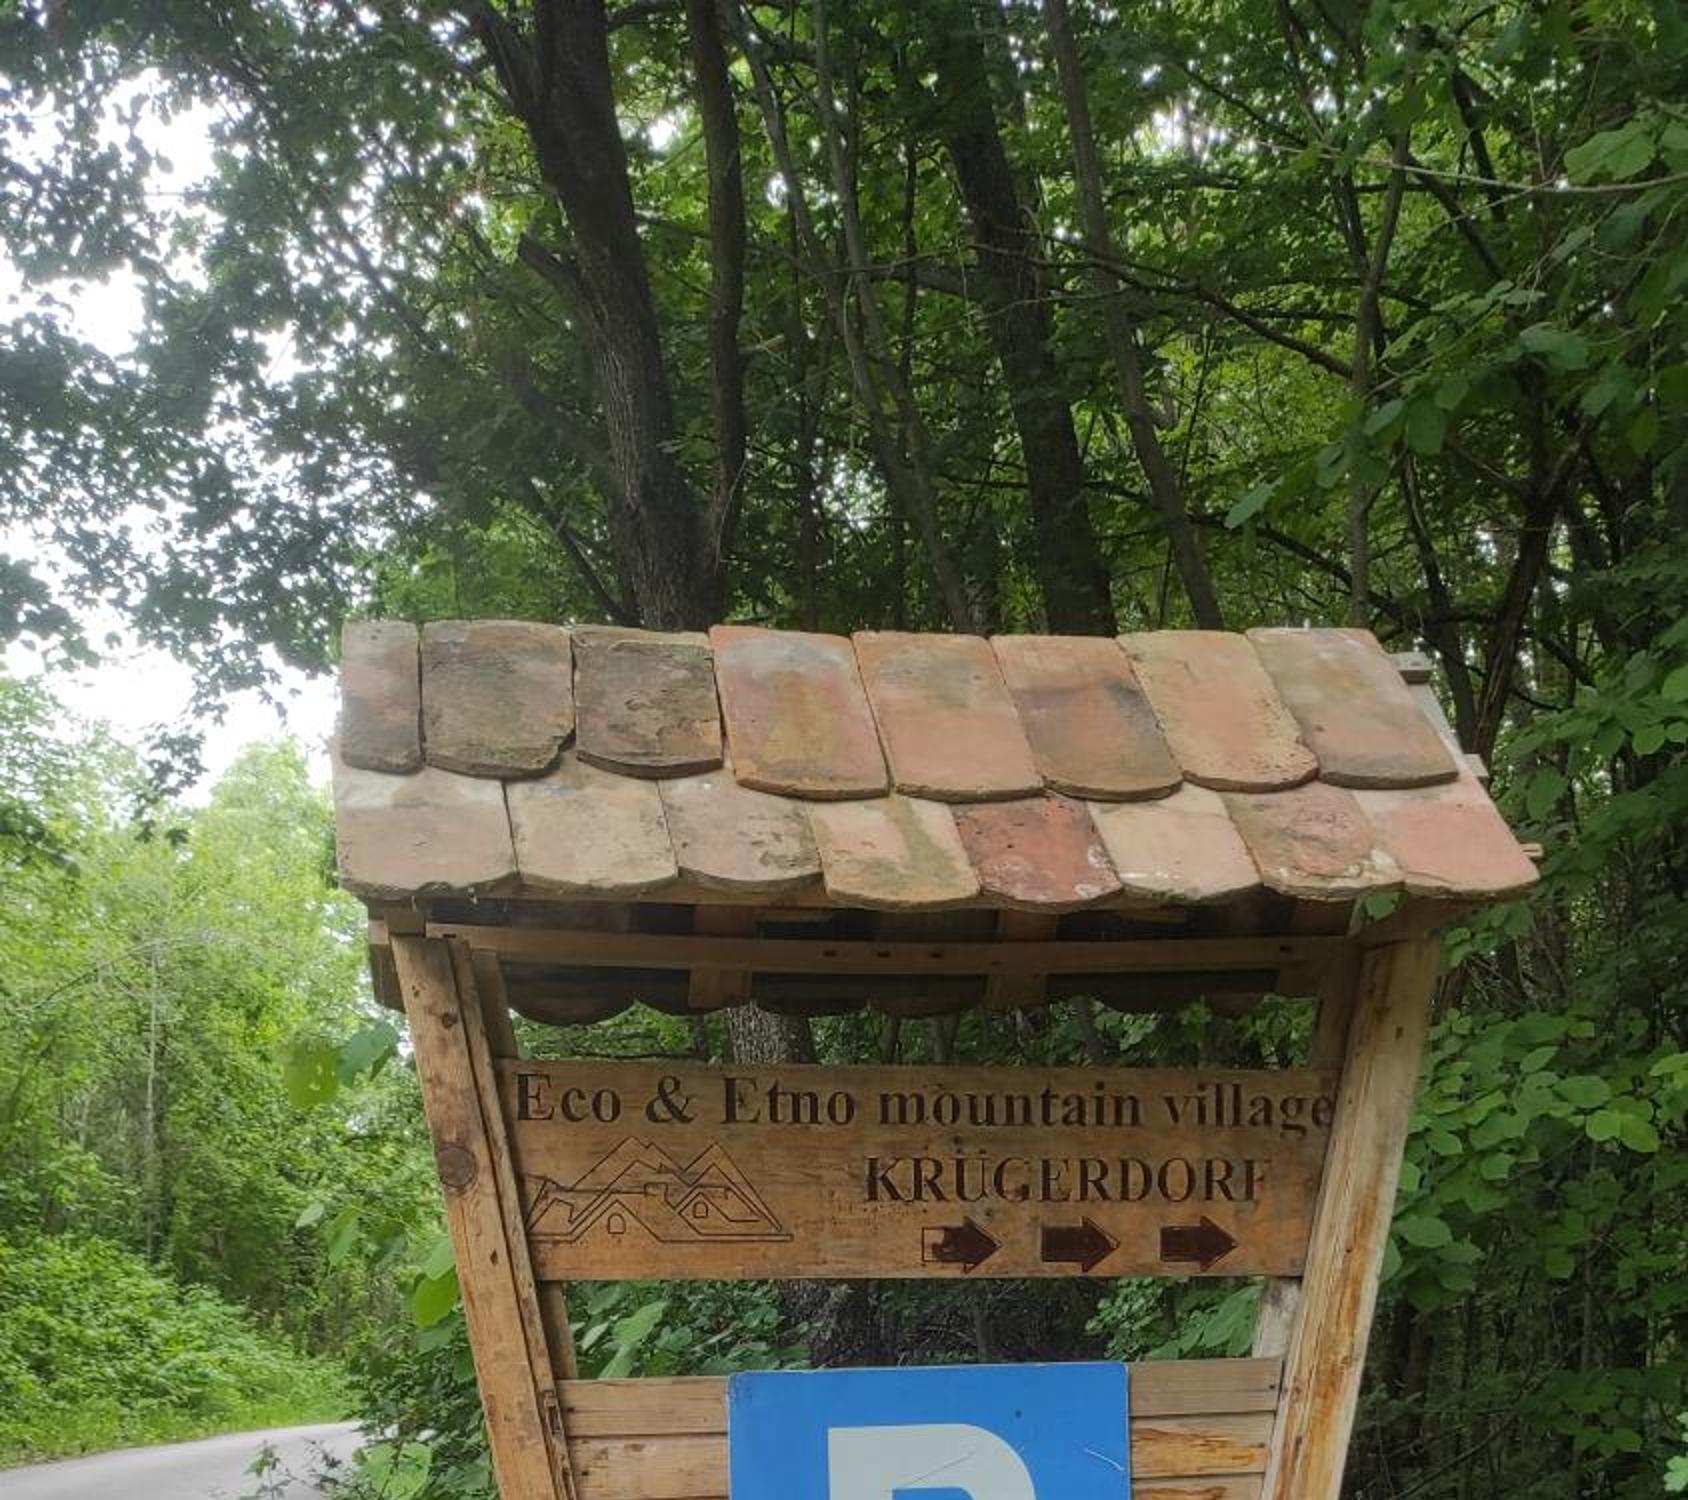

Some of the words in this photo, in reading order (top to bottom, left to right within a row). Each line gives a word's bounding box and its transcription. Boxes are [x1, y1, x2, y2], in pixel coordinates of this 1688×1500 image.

[516, 1072, 621, 1123] Eco
[645, 1075, 697, 1124] &
[721, 1073, 855, 1126] Etno
[879, 1081, 1144, 1127] mountain
[1163, 1083, 1337, 1139] village
[865, 1147, 1273, 1203] KRÜGERDORF
